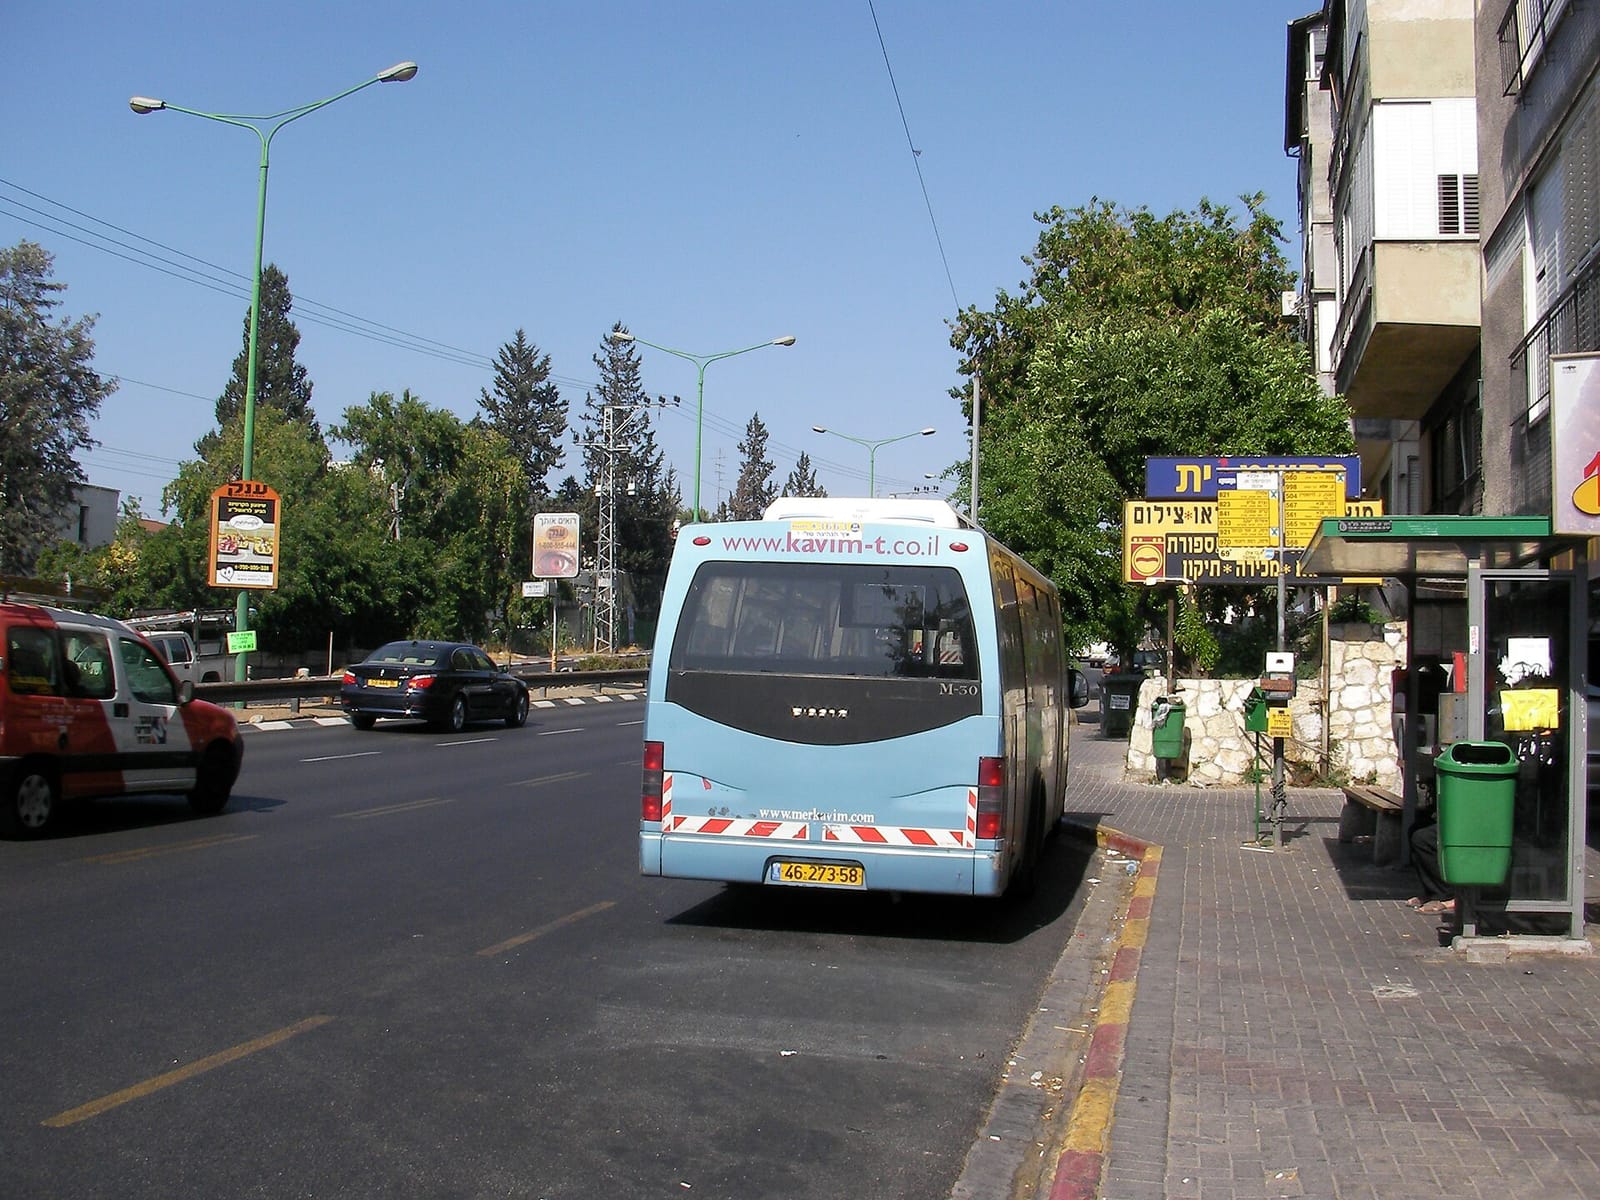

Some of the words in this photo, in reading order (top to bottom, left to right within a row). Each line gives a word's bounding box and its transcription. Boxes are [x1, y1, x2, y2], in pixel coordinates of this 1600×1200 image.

[227, 484, 268, 496] ענק
[539, 518, 557, 527] אותך
[1134, 505, 1184, 524] צילום
[722, 531, 939, 556] www.kavim-t.co.il
[1167, 536, 1218, 554] ספורת
[1182, 560, 1220, 581] תיקון
[1235, 560, 1280, 577] מכירה
[759, 808, 875, 824] www.merkavim.com
